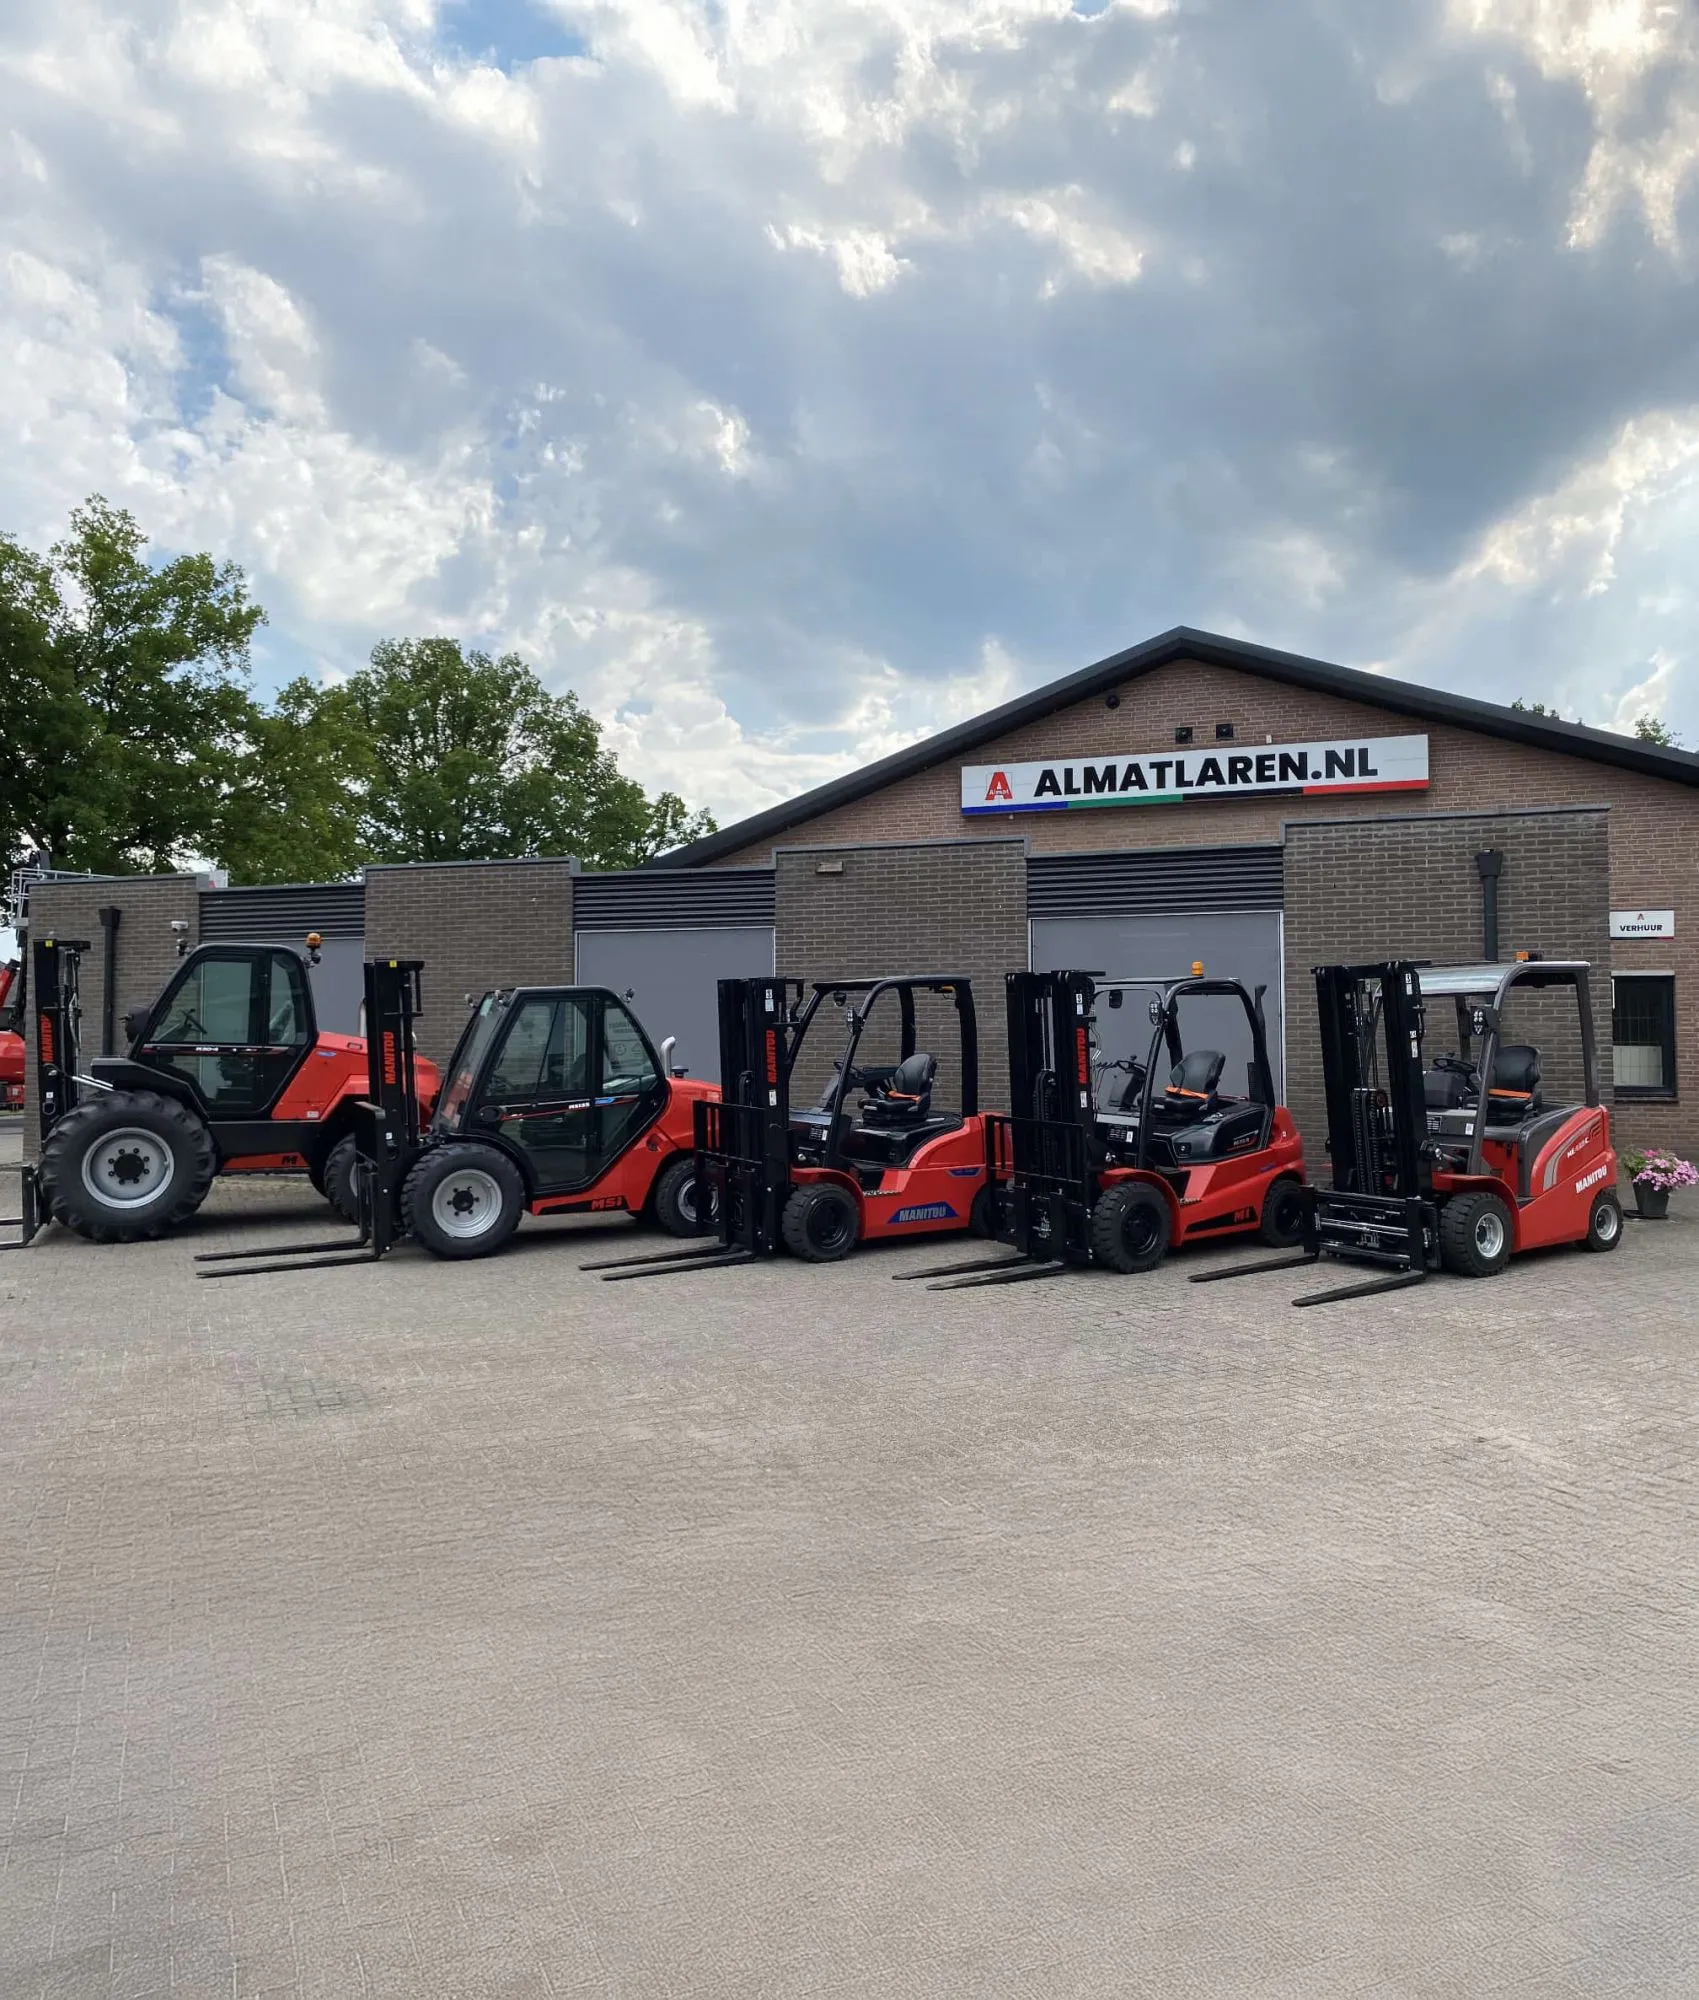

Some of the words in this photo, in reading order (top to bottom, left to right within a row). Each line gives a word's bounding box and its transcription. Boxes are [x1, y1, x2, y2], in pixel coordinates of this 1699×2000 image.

[1033, 747, 1378, 797] ALMATLAREN.NL
[1619, 924, 1663, 932] VERHUUR
[383, 1031, 396, 1085] MANITOU
[765, 1029, 777, 1084] MANITOU
[1075, 1027, 1087, 1084] MANITOU
[1575, 1165, 1607, 1193] MANITOU
[591, 1196, 622, 1211] MSI
[899, 1205, 946, 1222] MANITOU
